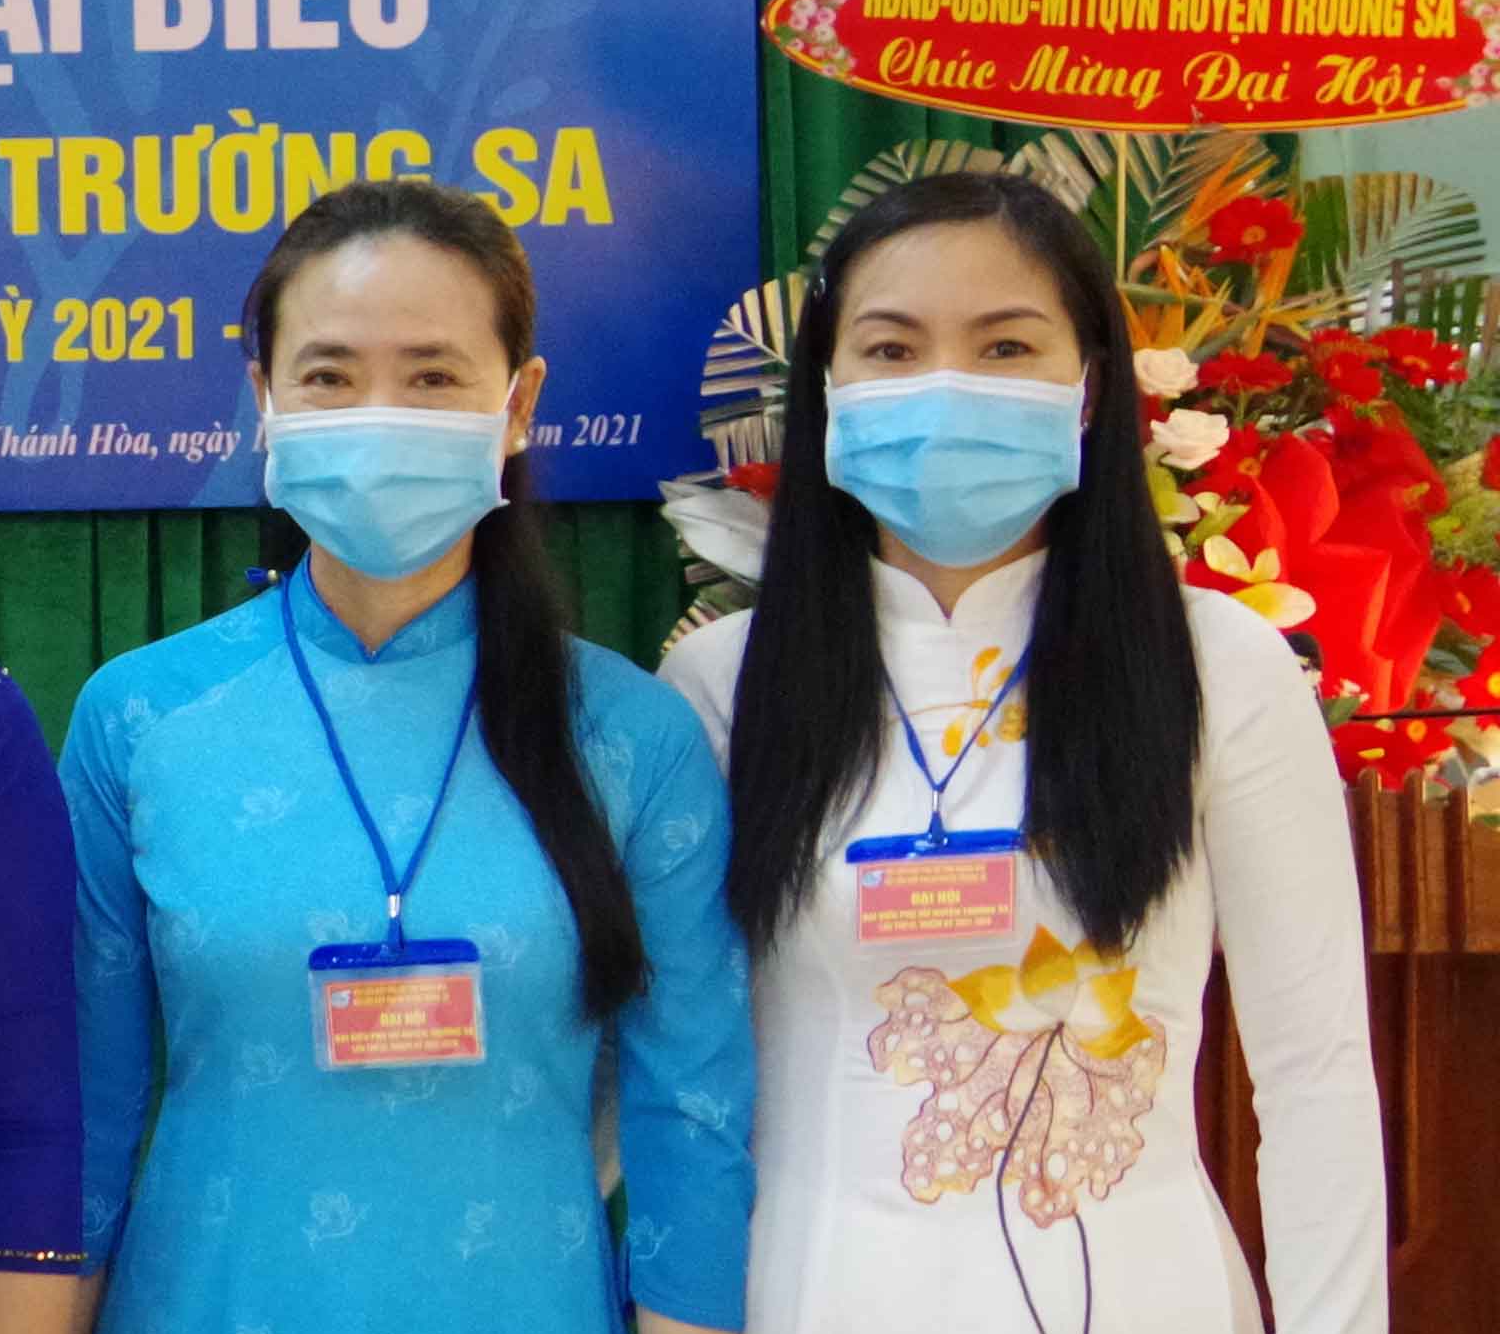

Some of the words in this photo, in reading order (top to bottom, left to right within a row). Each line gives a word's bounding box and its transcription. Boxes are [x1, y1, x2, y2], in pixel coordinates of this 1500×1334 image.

[879, 36, 996, 89] Chúc
[1010, 44, 1163, 110] Mừng
[1182, 50, 1291, 112] Đại
[1315, 54, 1426, 114] Hội
[473, 127, 614, 228] SA
[53, 297, 193, 362] 2021
[88, 422, 158, 458] Hòa,
[168, 421, 241, 463] ngày
[572, 414, 642, 446] 2021
